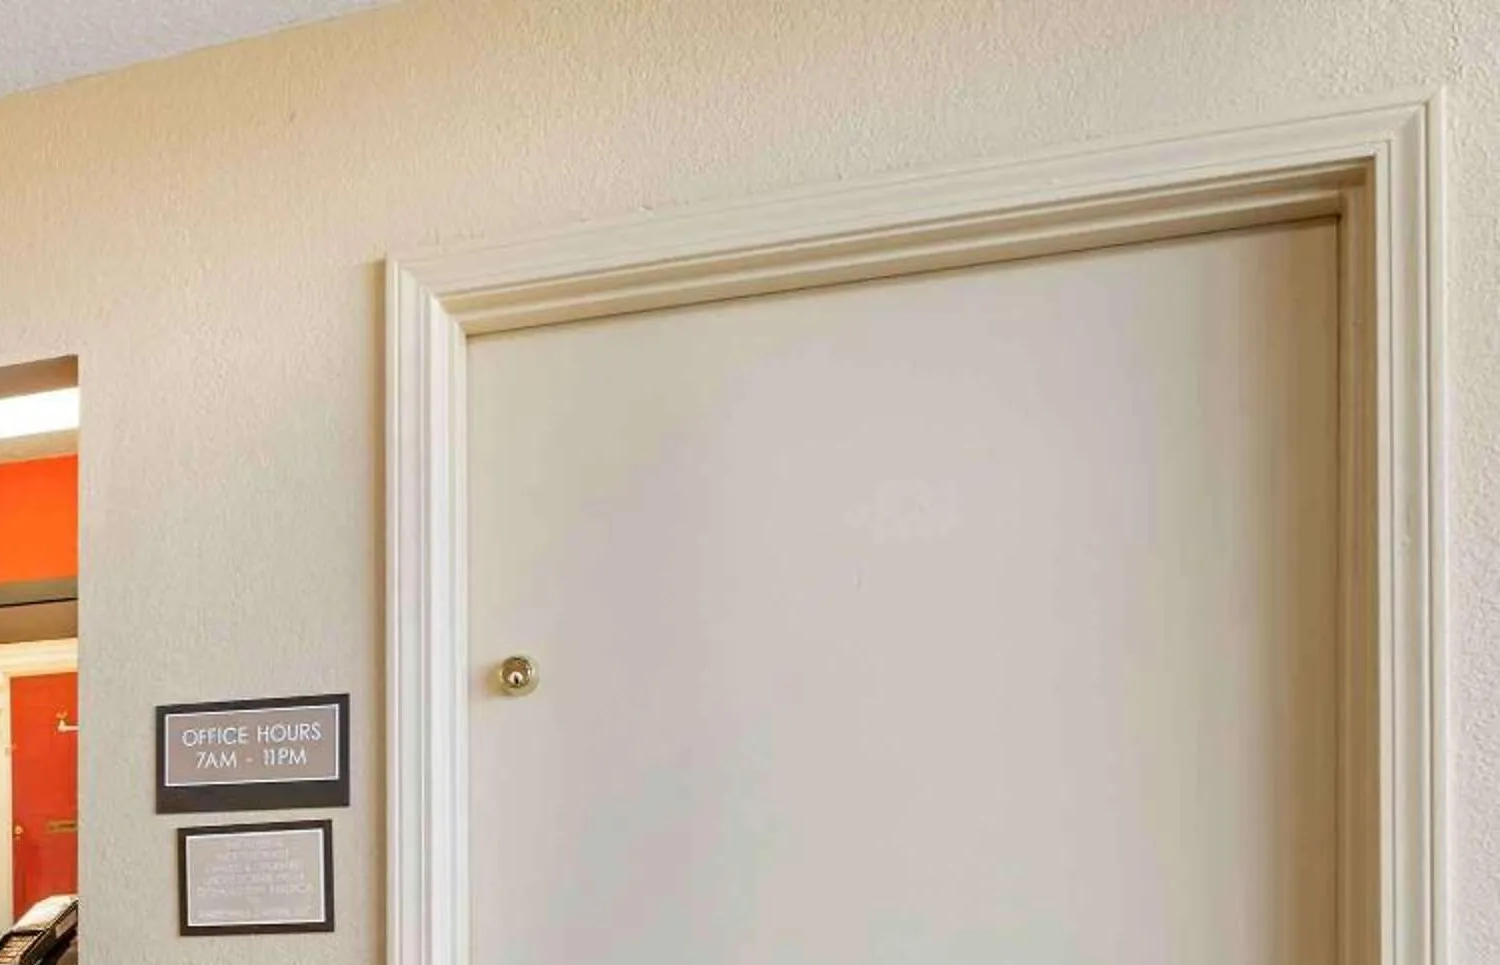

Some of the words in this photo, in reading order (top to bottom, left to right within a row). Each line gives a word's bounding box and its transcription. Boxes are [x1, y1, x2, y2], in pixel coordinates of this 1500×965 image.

[182, 726, 249, 747] OFFICE
[257, 721, 322, 743] HOURS
[196, 751, 237, 769] 7AM
[263, 749, 308, 767] 11PM
